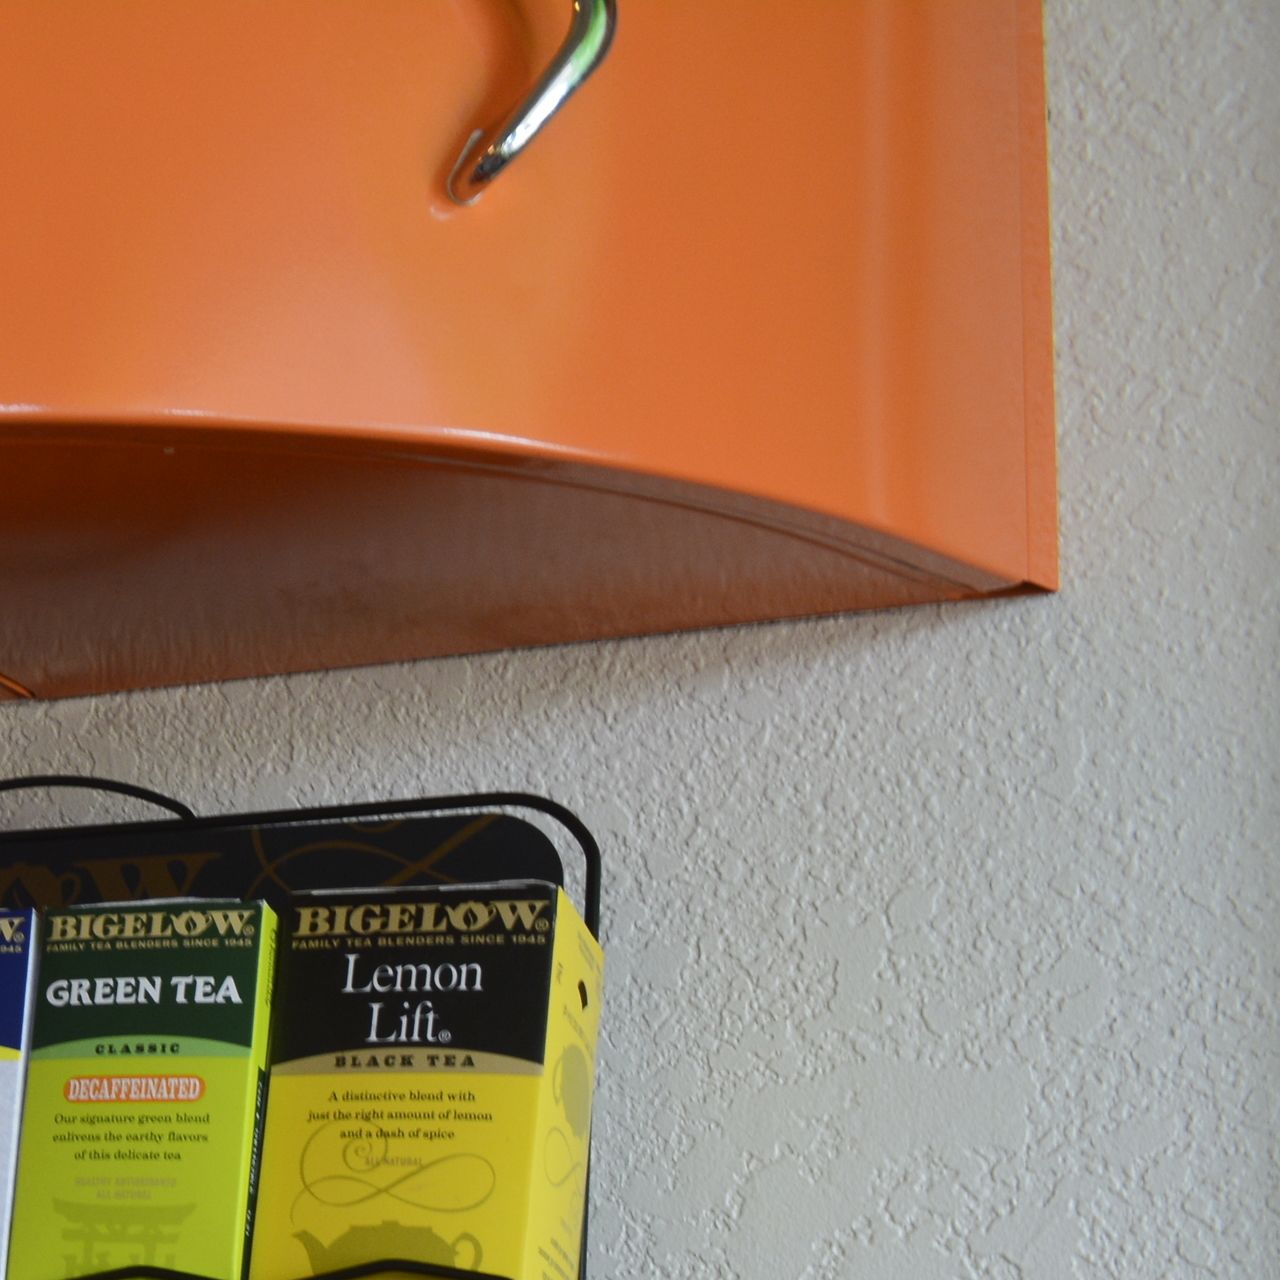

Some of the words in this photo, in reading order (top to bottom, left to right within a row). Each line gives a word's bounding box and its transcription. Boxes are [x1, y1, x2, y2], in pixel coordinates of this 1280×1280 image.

[292, 939, 340, 949] FAMILY
[347, 937, 371, 947] TEA
[378, 936, 454, 947] BLENDERS
[461, 935, 504, 944] SINCE
[512, 934, 545, 944] 1945
[342, 954, 483, 993] Lemon
[46, 976, 161, 1007] GREEN
[171, 975, 242, 1003] TEA
[365, 1001, 439, 1043] Lift
[96, 1044, 180, 1055] CLASSIC
[335, 1055, 413, 1068] BLACK
[427, 1055, 474, 1067] TEA
[68, 1078, 200, 1100] DECAFFEINATED
[329, 1091, 338, 1102] A
[342, 1091, 405, 1102] distinctive
[410, 1091, 443, 1102] blend
[447, 1091, 475, 1102] with
[308, 1111, 330, 1122] just
[333, 1110, 352, 1120] the
[355, 1110, 384, 1121] right
[387, 1111, 435, 1120] amount
[438, 1110, 451, 1120] of
[454, 1111, 492, 1121] lemon
[340, 1129, 362, 1139] and
[366, 1131, 372, 1139] a
[376, 1129, 404, 1139] dash
[409, 1129, 421, 1139] of
[423, 1130, 454, 1140] spice
